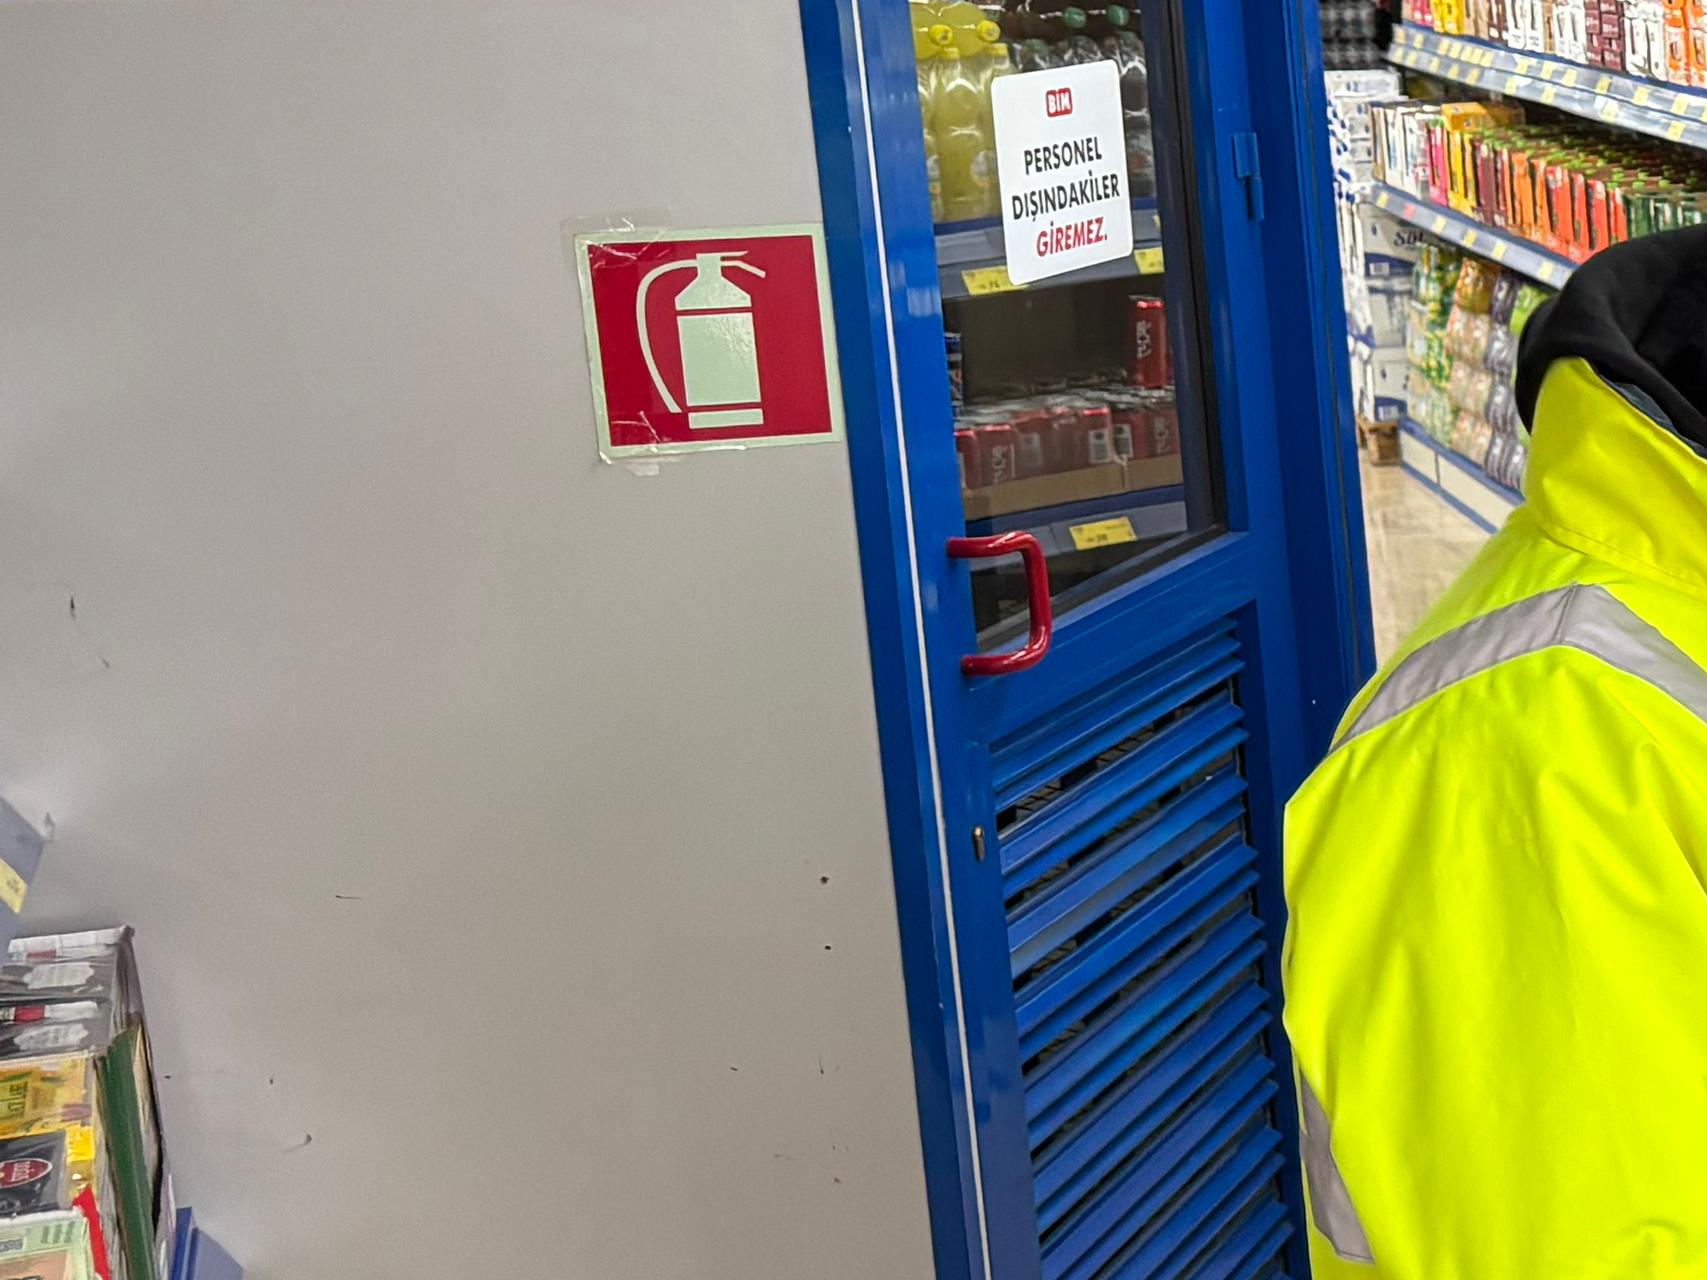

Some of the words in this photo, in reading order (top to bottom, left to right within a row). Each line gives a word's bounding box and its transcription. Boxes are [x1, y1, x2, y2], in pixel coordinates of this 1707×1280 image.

[1024, 136, 1102, 175] PERSONEL
[1012, 170, 1120, 222] DIŞINDAKİLER
[1036, 217, 1107, 257] GİREMEZ.
